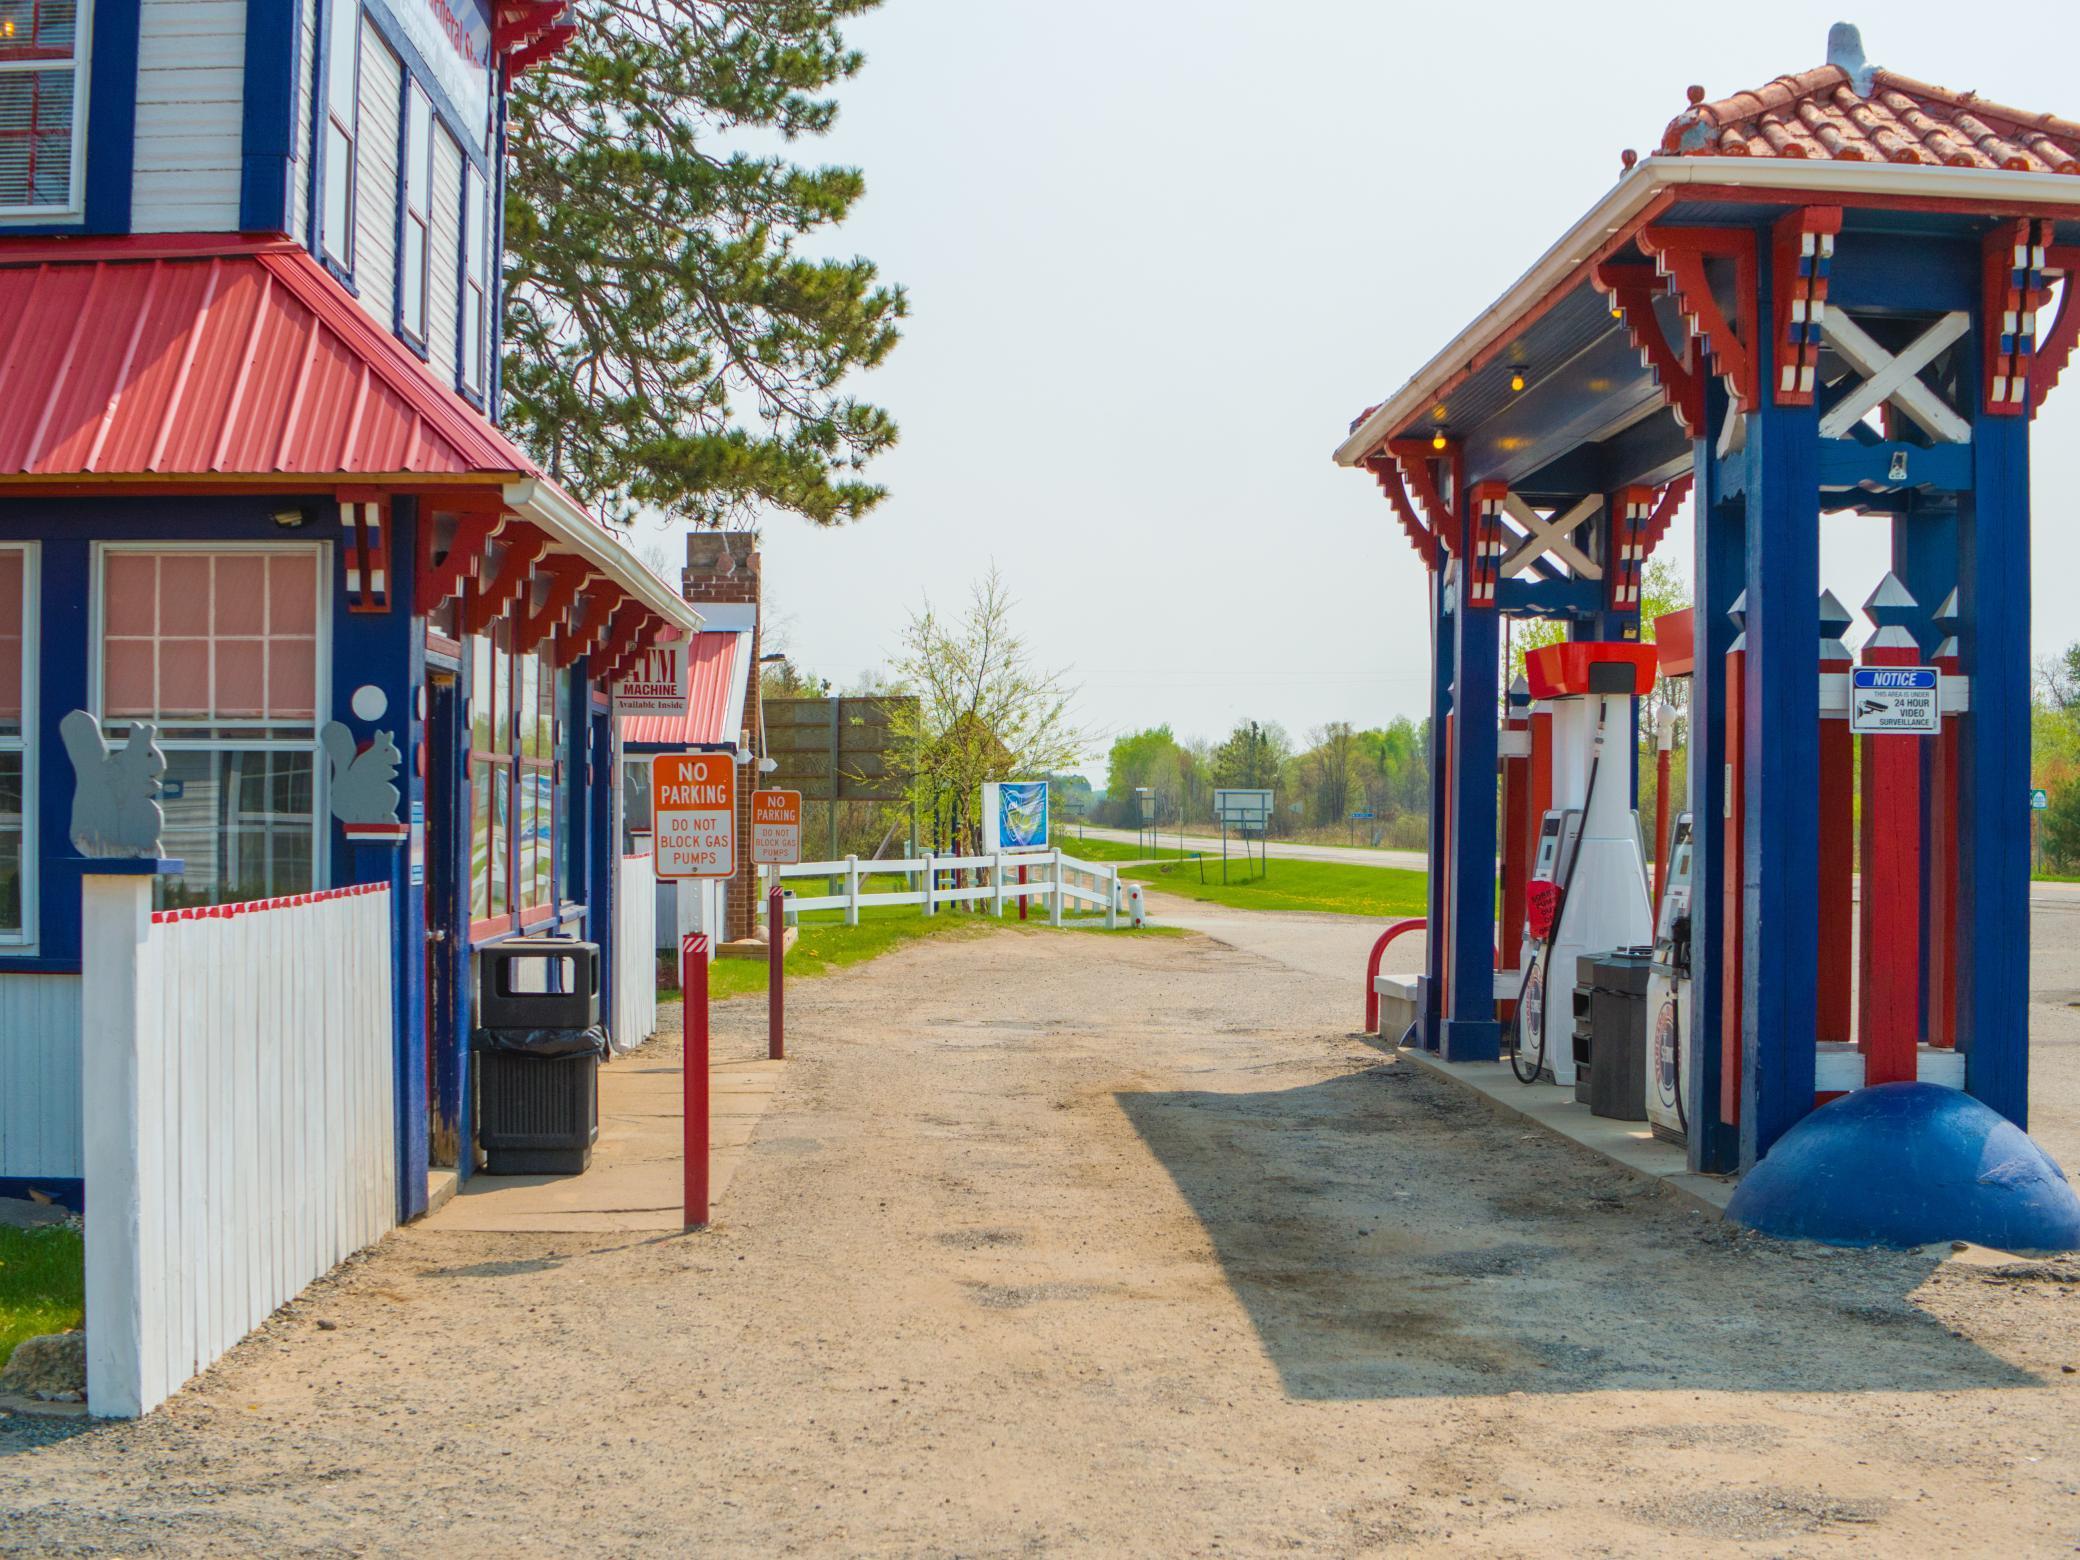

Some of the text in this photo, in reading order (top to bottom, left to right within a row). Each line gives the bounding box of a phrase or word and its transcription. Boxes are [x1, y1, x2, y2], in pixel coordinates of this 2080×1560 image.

[428, 0, 463, 59] eneral
[1873, 672, 1917, 686] NOTICE
[623, 684, 677, 695] MACHINE
[618, 700, 683, 709] Available Inside
[1894, 699, 1929, 707] 24 HOUR
[1900, 709, 1924, 717] VIDEO
[678, 763, 708, 782] NO
[661, 785, 726, 804] PARKING
[767, 796, 785, 807] NO
[757, 810, 795, 821] PARKING
[672, 819, 717, 831] DO NOT
[763, 829, 789, 837] DO NOT
[661, 836, 728, 848] BLOCK GAS
[756, 838, 796, 847] BLOCK GAS
[673, 853, 716, 864] PUMPS
